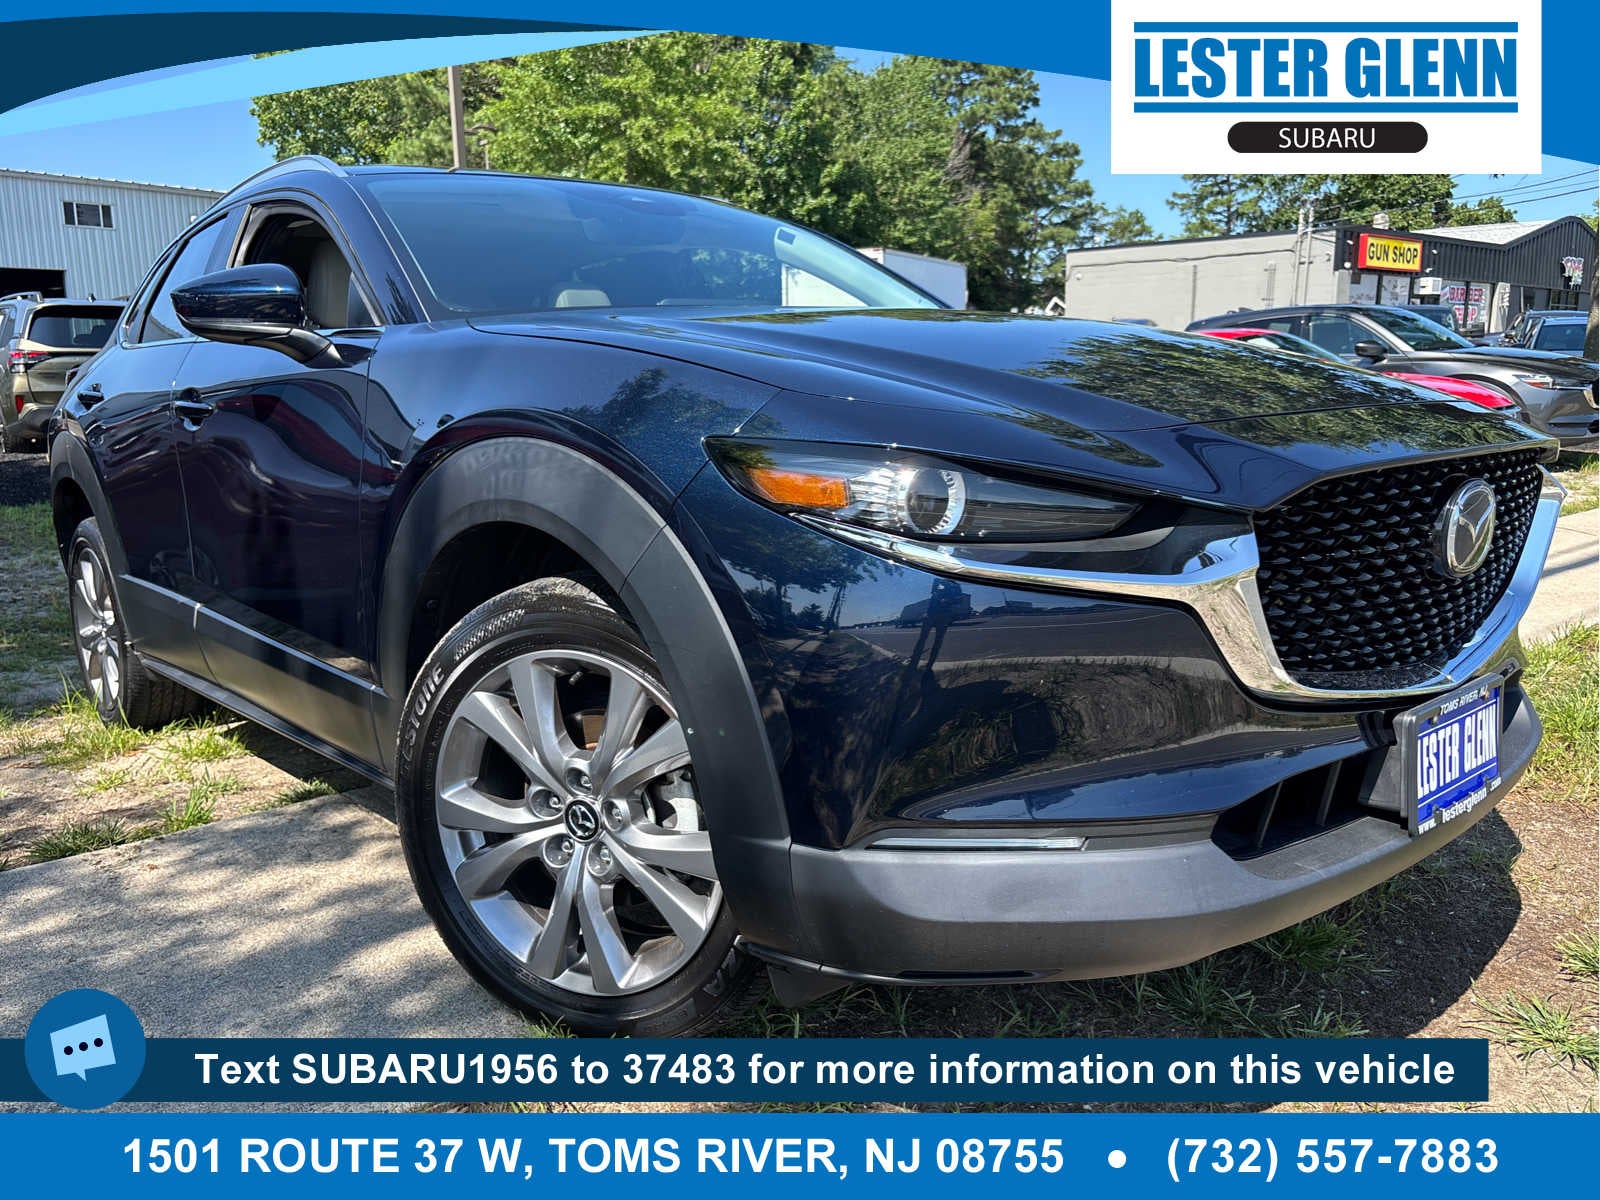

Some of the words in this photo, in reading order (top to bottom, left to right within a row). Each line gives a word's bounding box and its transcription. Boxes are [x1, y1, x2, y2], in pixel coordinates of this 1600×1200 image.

[1368, 242, 1390, 262] GUN
[1392, 245, 1418, 264] SHOP
[1417, 722, 1460, 800] LESTER
[1463, 703, 1497, 773] GLENN
